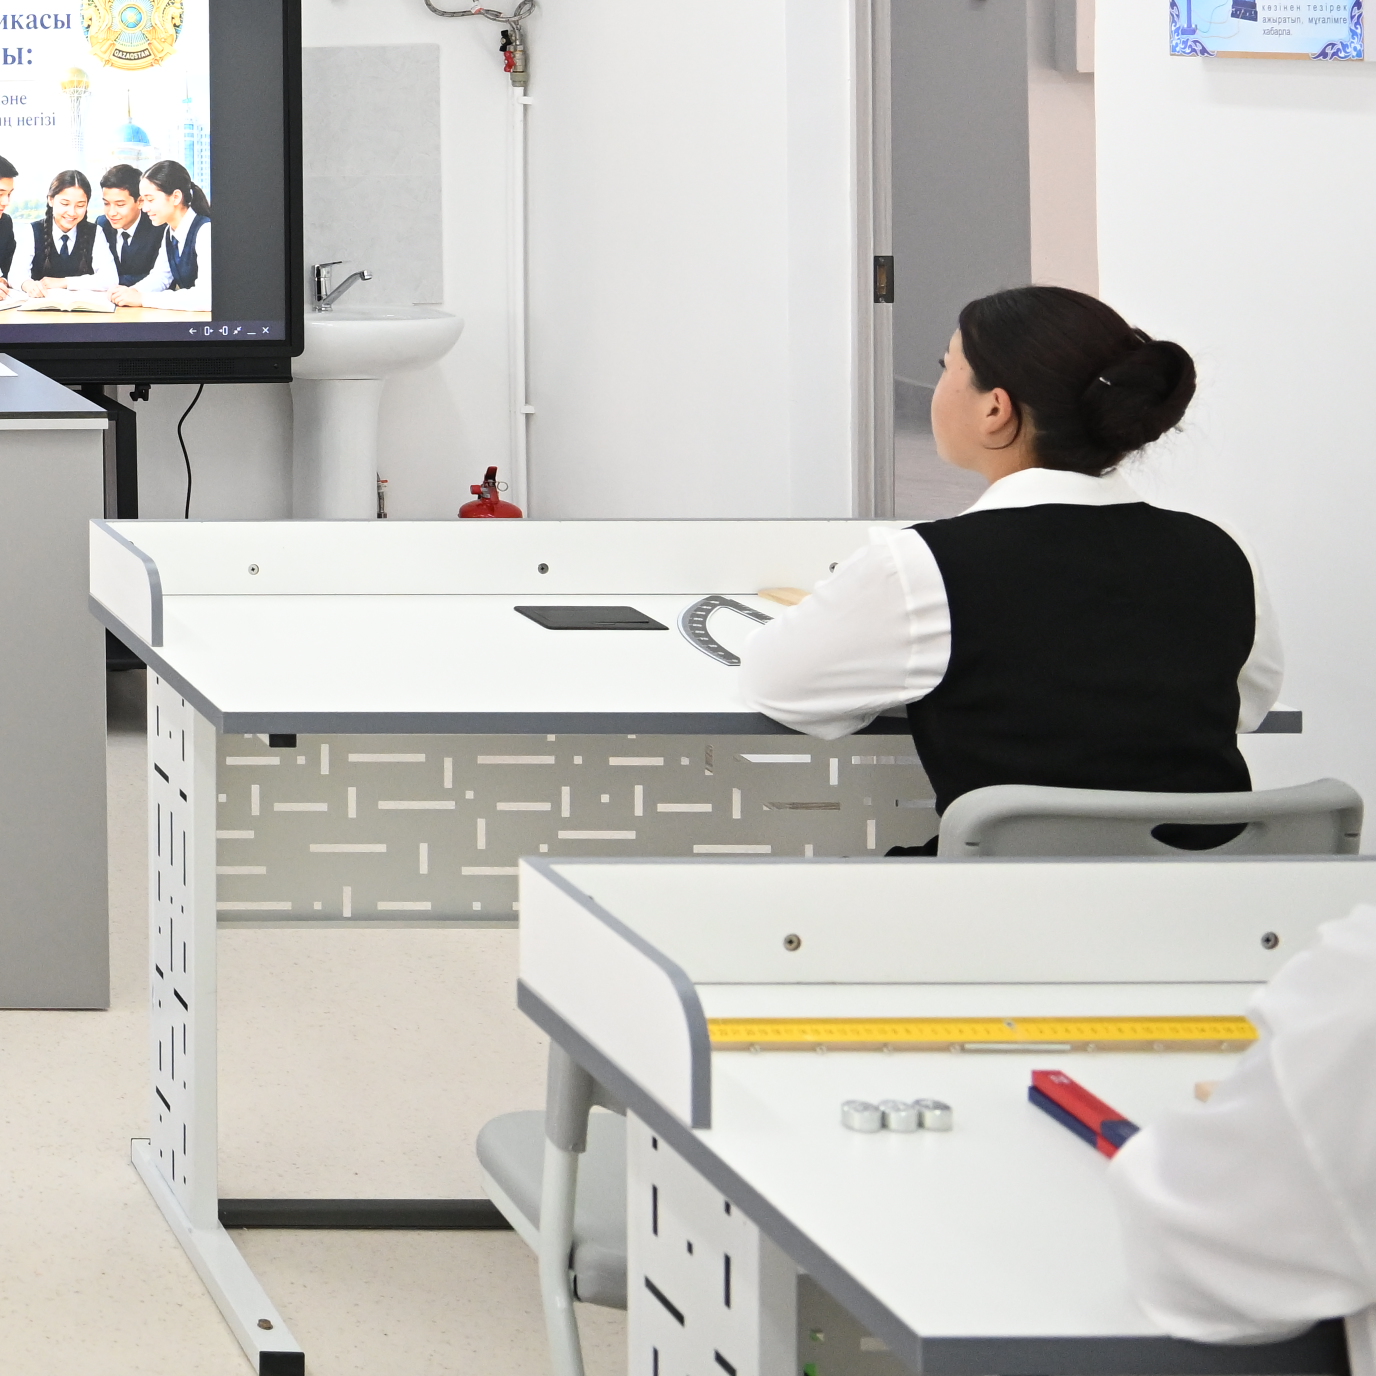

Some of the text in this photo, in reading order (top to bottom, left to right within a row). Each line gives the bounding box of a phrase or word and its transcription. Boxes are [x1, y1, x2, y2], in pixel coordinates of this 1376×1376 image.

[1261, 3, 1348, 13] көзінен тезірек
[114, 49, 150, 60] QAZAQSTAN
[16, 112, 56, 128] негізі
